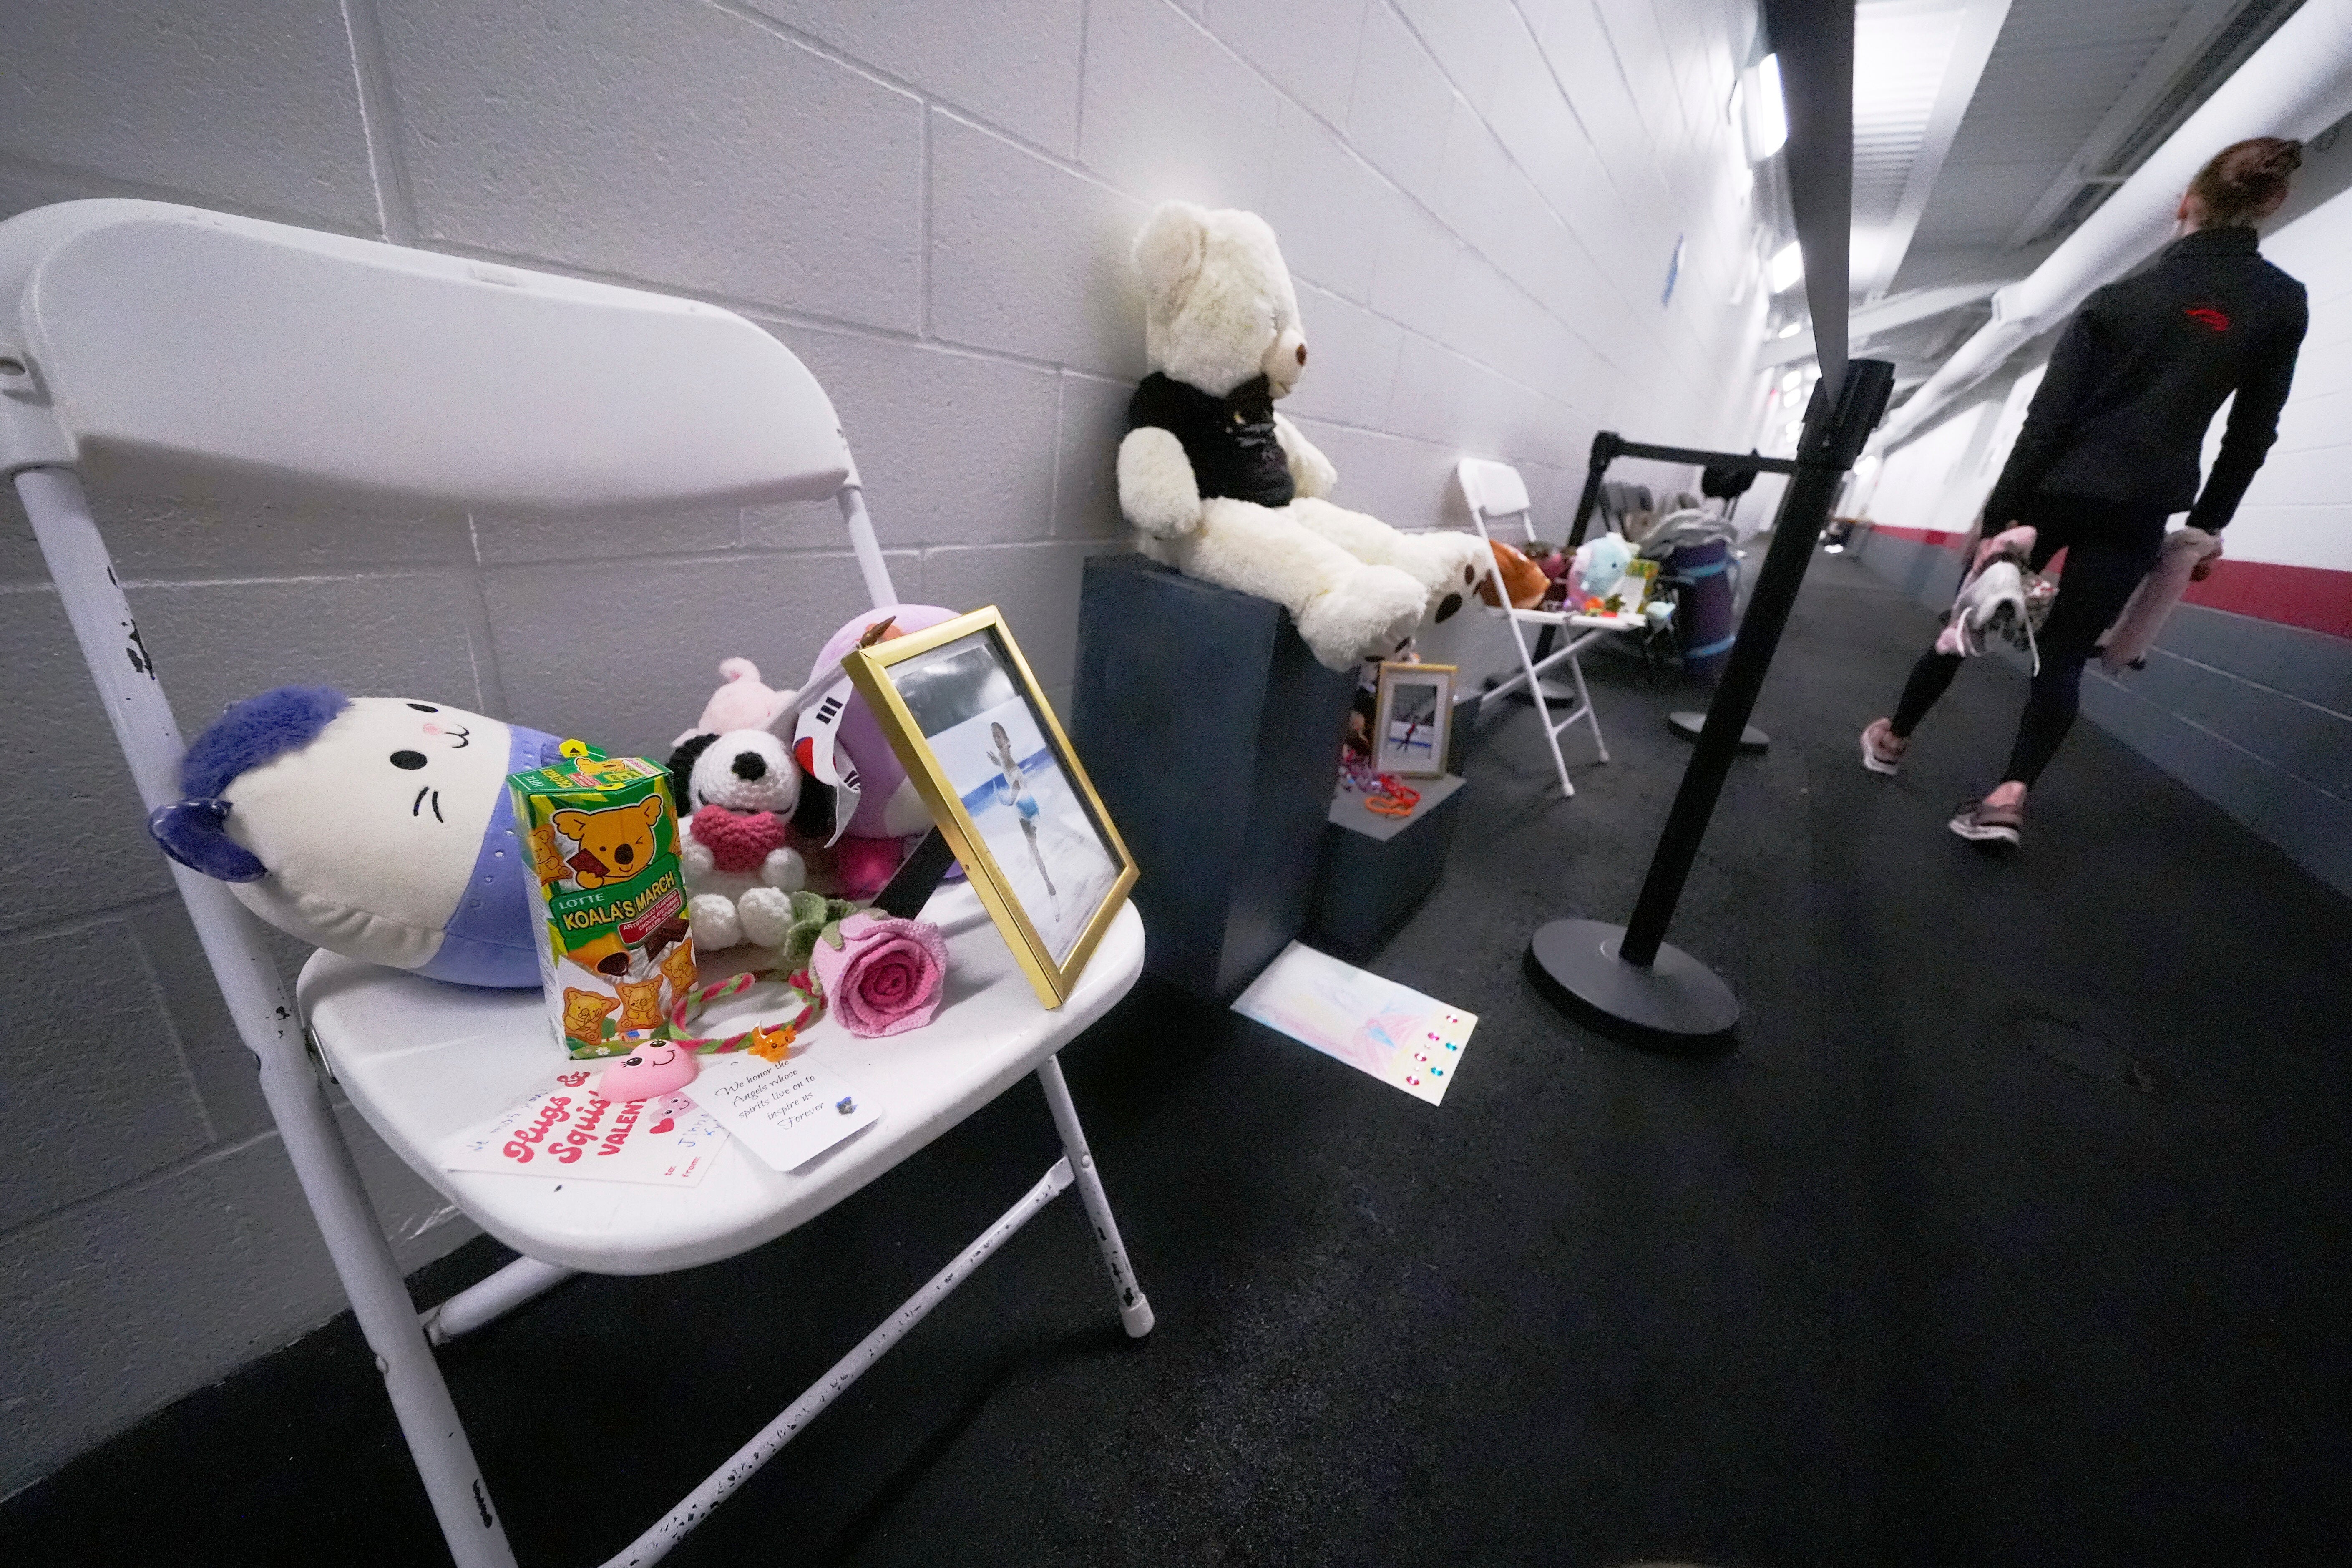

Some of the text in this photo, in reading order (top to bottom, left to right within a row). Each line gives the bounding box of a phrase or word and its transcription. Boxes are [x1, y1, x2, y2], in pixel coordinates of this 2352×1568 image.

[523, 776, 544, 787] LOTTE
[559, 893, 604, 909] LOTTE
[563, 871, 674, 930] KOALA'S MARCH
[623, 891, 677, 930] ARTIFICIALLY FLAVORED
[639, 896, 679, 931] CHOCOLATE CREME
[646, 902, 680, 932] FILLED COOKIES
[715, 1060, 789, 1096] We honor the
[733, 1070, 797, 1107] Angels whose
[739, 1099, 770, 1119] spirits
[772, 1089, 790, 1101] live
[793, 1081, 804, 1090] on
[767, 1092, 813, 1120] inspire us
[777, 1102, 824, 1130] Forever
[503, 1097, 571, 1163] Hugs
[548, 1090, 611, 1164] Squis
